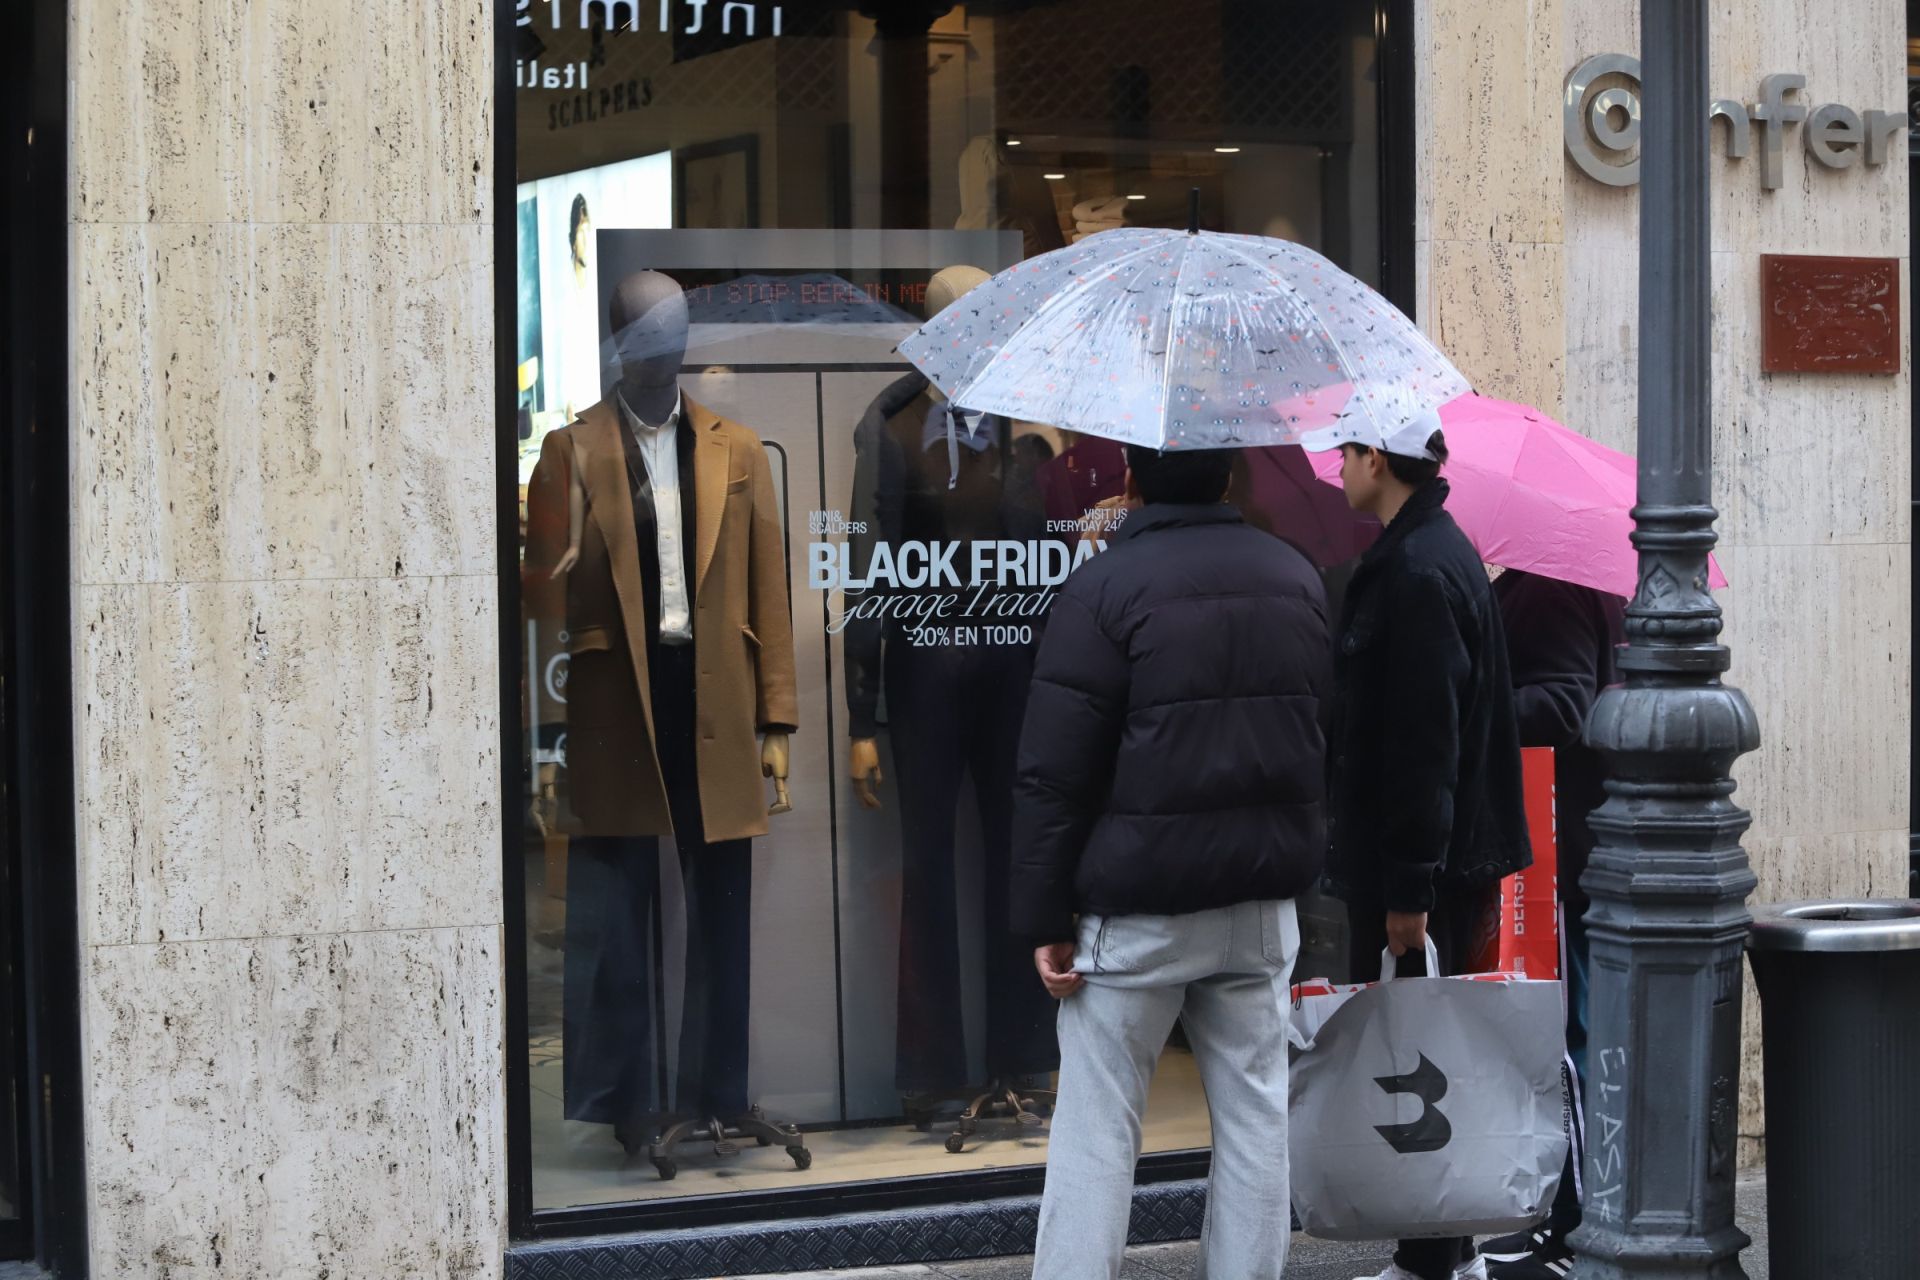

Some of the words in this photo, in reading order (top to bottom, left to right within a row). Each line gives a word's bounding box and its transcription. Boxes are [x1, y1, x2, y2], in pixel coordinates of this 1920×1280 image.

[547, 79, 653, 131] SCALPERS
[809, 510, 842, 522] MINI&
[1084, 508, 1111, 520] VISIT
[1113, 508, 1128, 520] US
[809, 521, 867, 534] SCALPERS
[1046, 520, 1102, 532] EVERYDAY
[1103, 520, 1124, 532] 24/
[809, 540, 962, 589] BLACK
[826, 568, 959, 634] Garage
[907, 626, 950, 646] -20%
[954, 626, 978, 646] EN
[983, 625, 1032, 645] TODO
